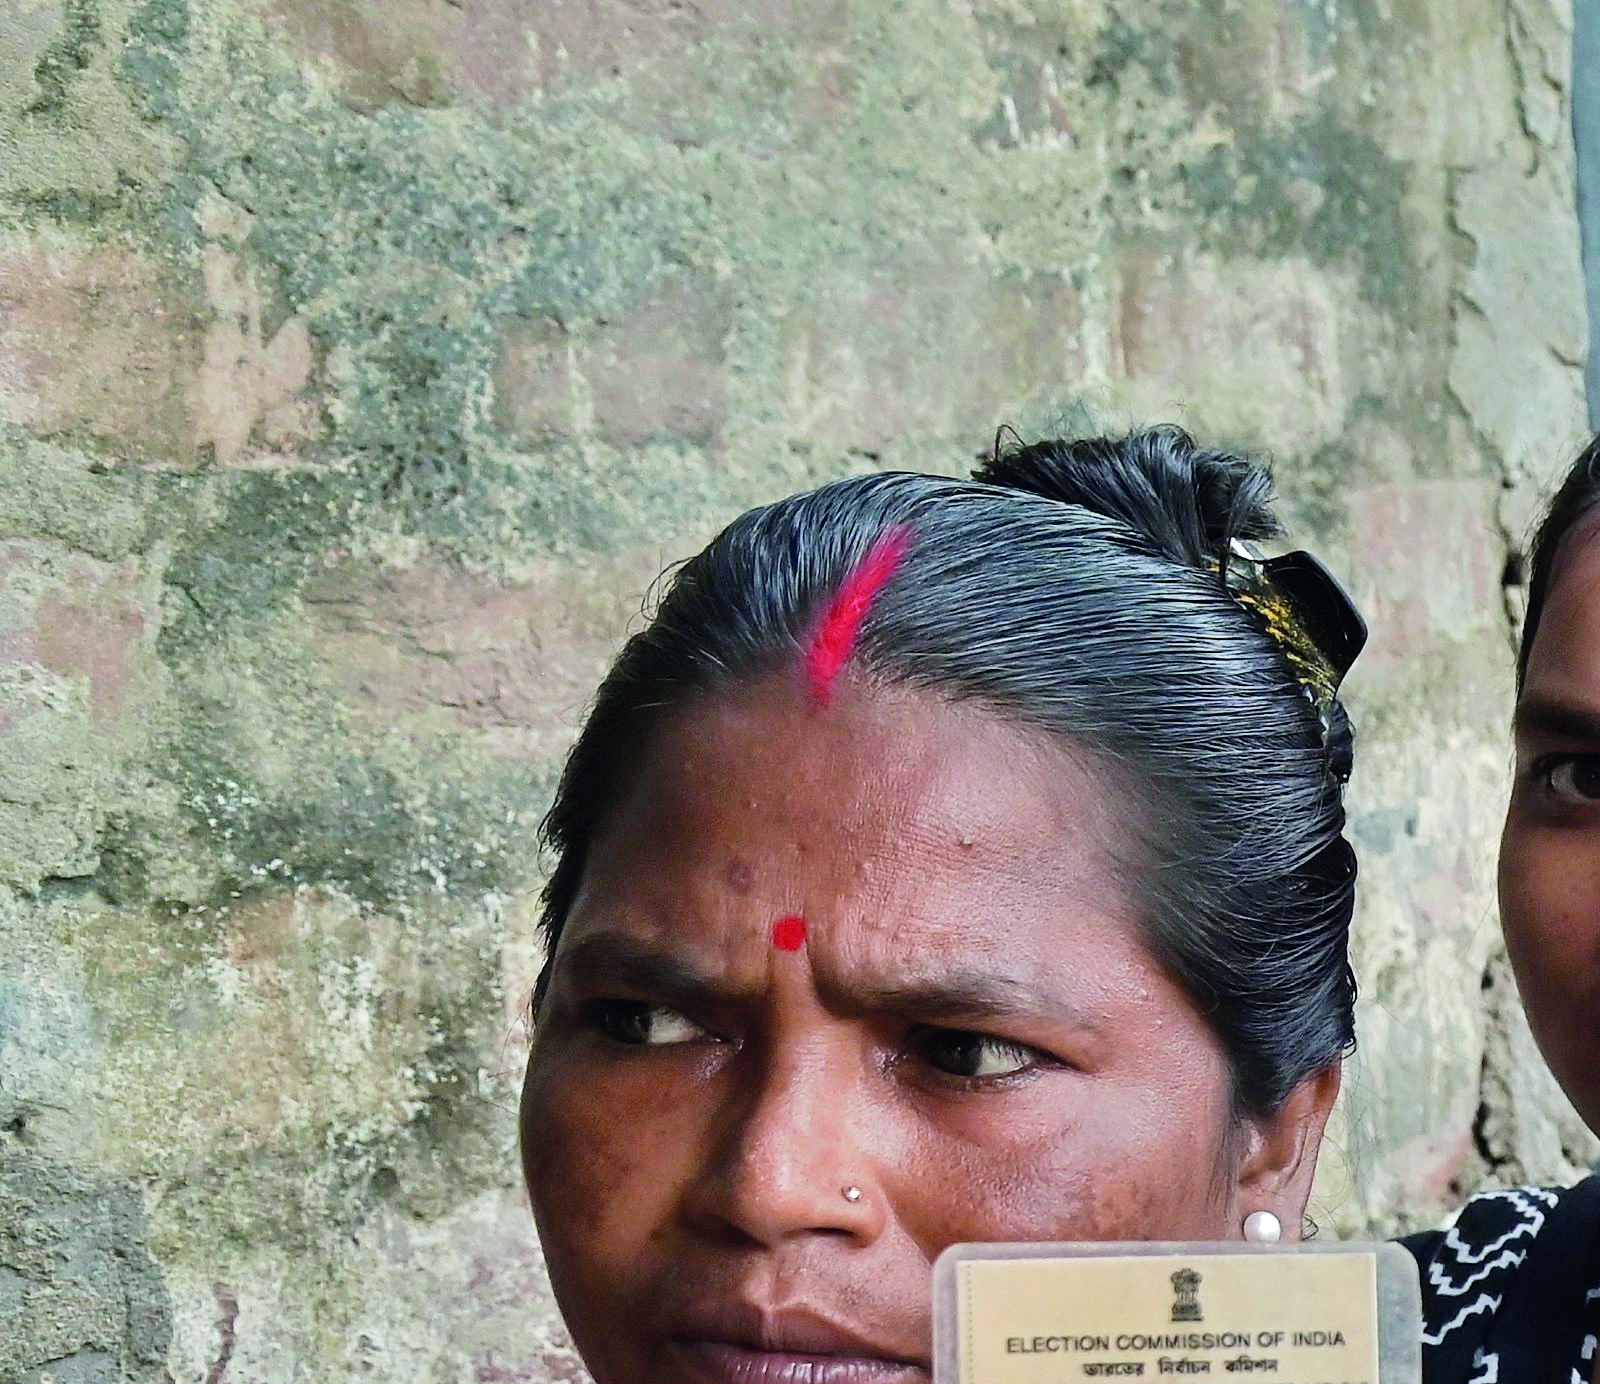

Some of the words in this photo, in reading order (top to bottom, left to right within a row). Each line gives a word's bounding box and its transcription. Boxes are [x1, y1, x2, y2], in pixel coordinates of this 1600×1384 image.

[1006, 1335, 1110, 1354] ELECTION
[1116, 1332, 1251, 1351] COMMISSION
[1257, 1331, 1285, 1348] OF
[1293, 1331, 1345, 1347] INDIA
[1082, 1362, 1146, 1376] ভারতের
[1157, 1356, 1212, 1374] নির্বাচন
[1224, 1355, 1279, 1372] কমিশন
